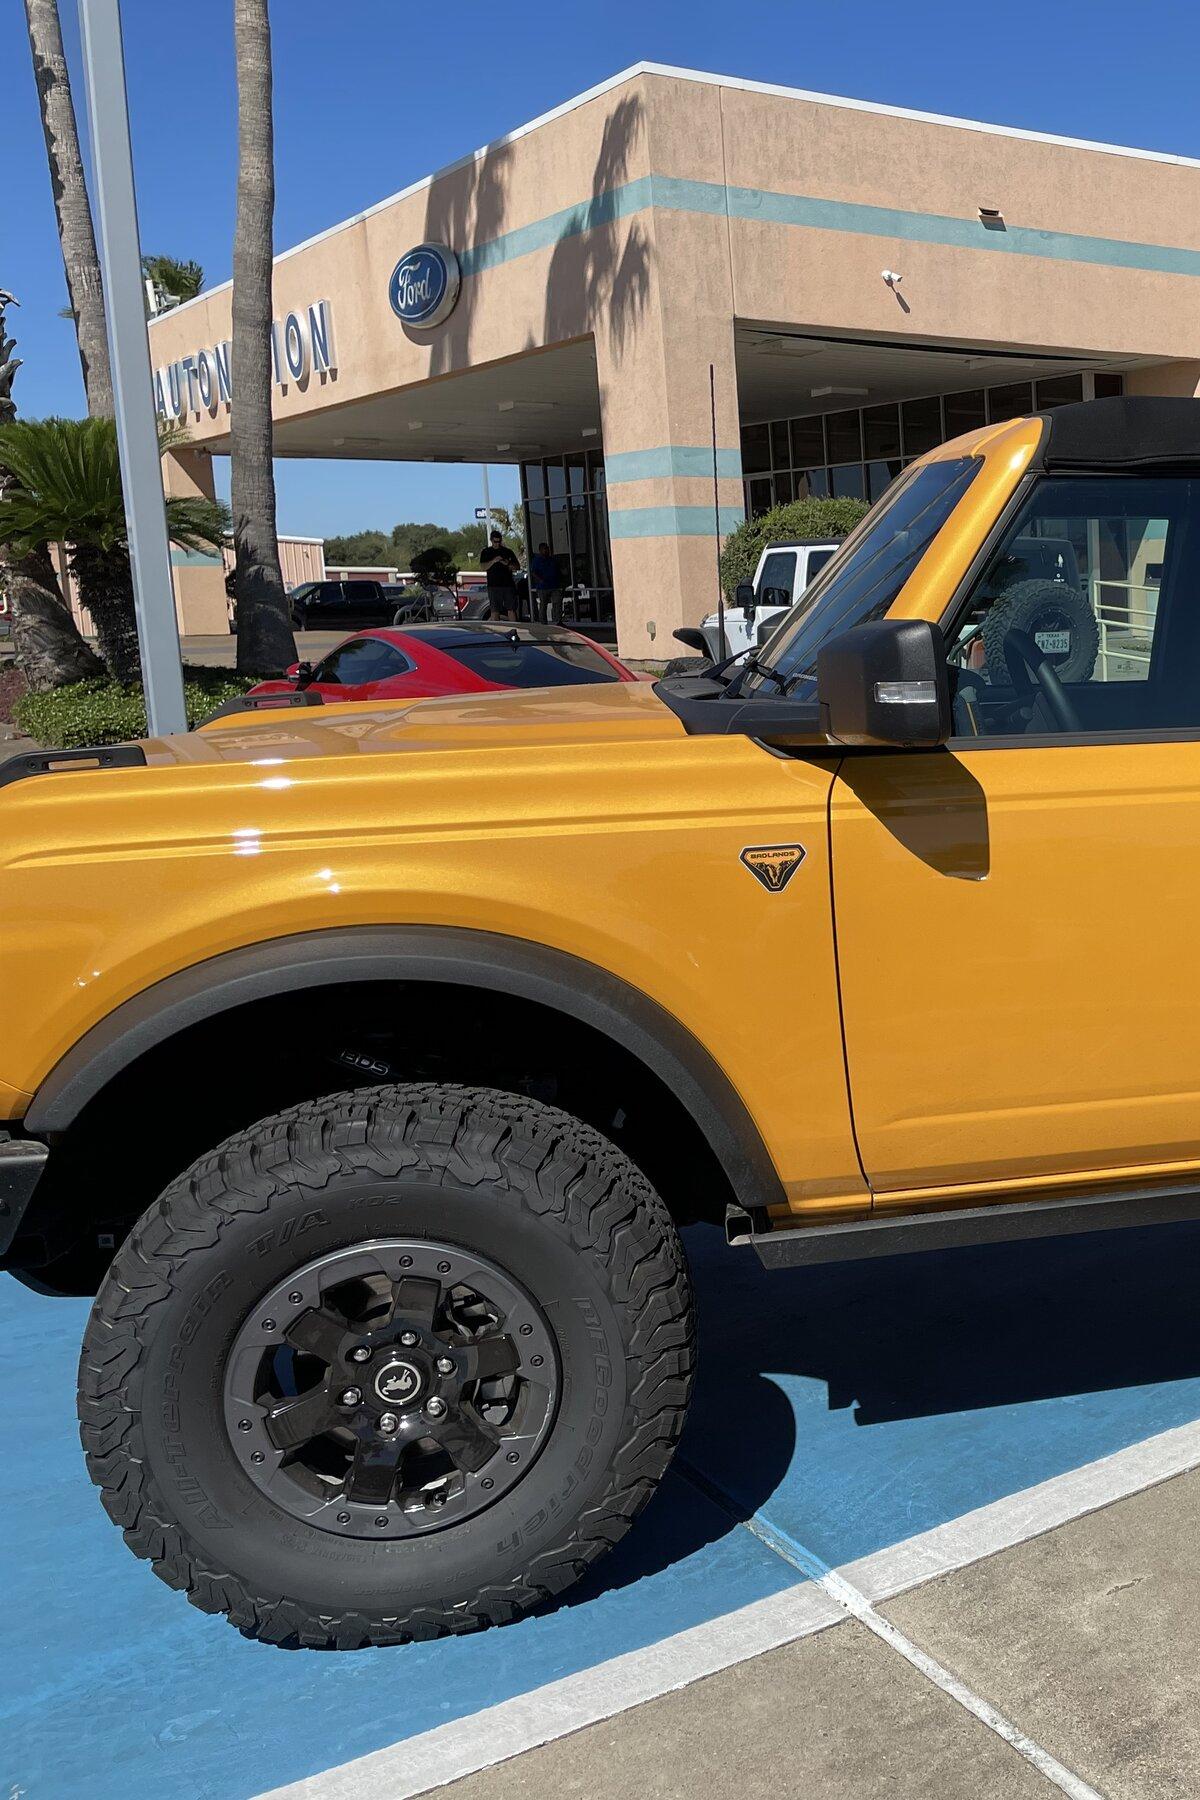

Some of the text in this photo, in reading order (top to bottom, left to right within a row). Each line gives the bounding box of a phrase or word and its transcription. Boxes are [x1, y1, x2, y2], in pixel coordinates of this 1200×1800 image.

[397, 261, 432, 310] Ford
[152, 299, 334, 420] AUTONION
[750, 850, 796, 859] BADLANDS
[245, 1208, 332, 1258] T/A
